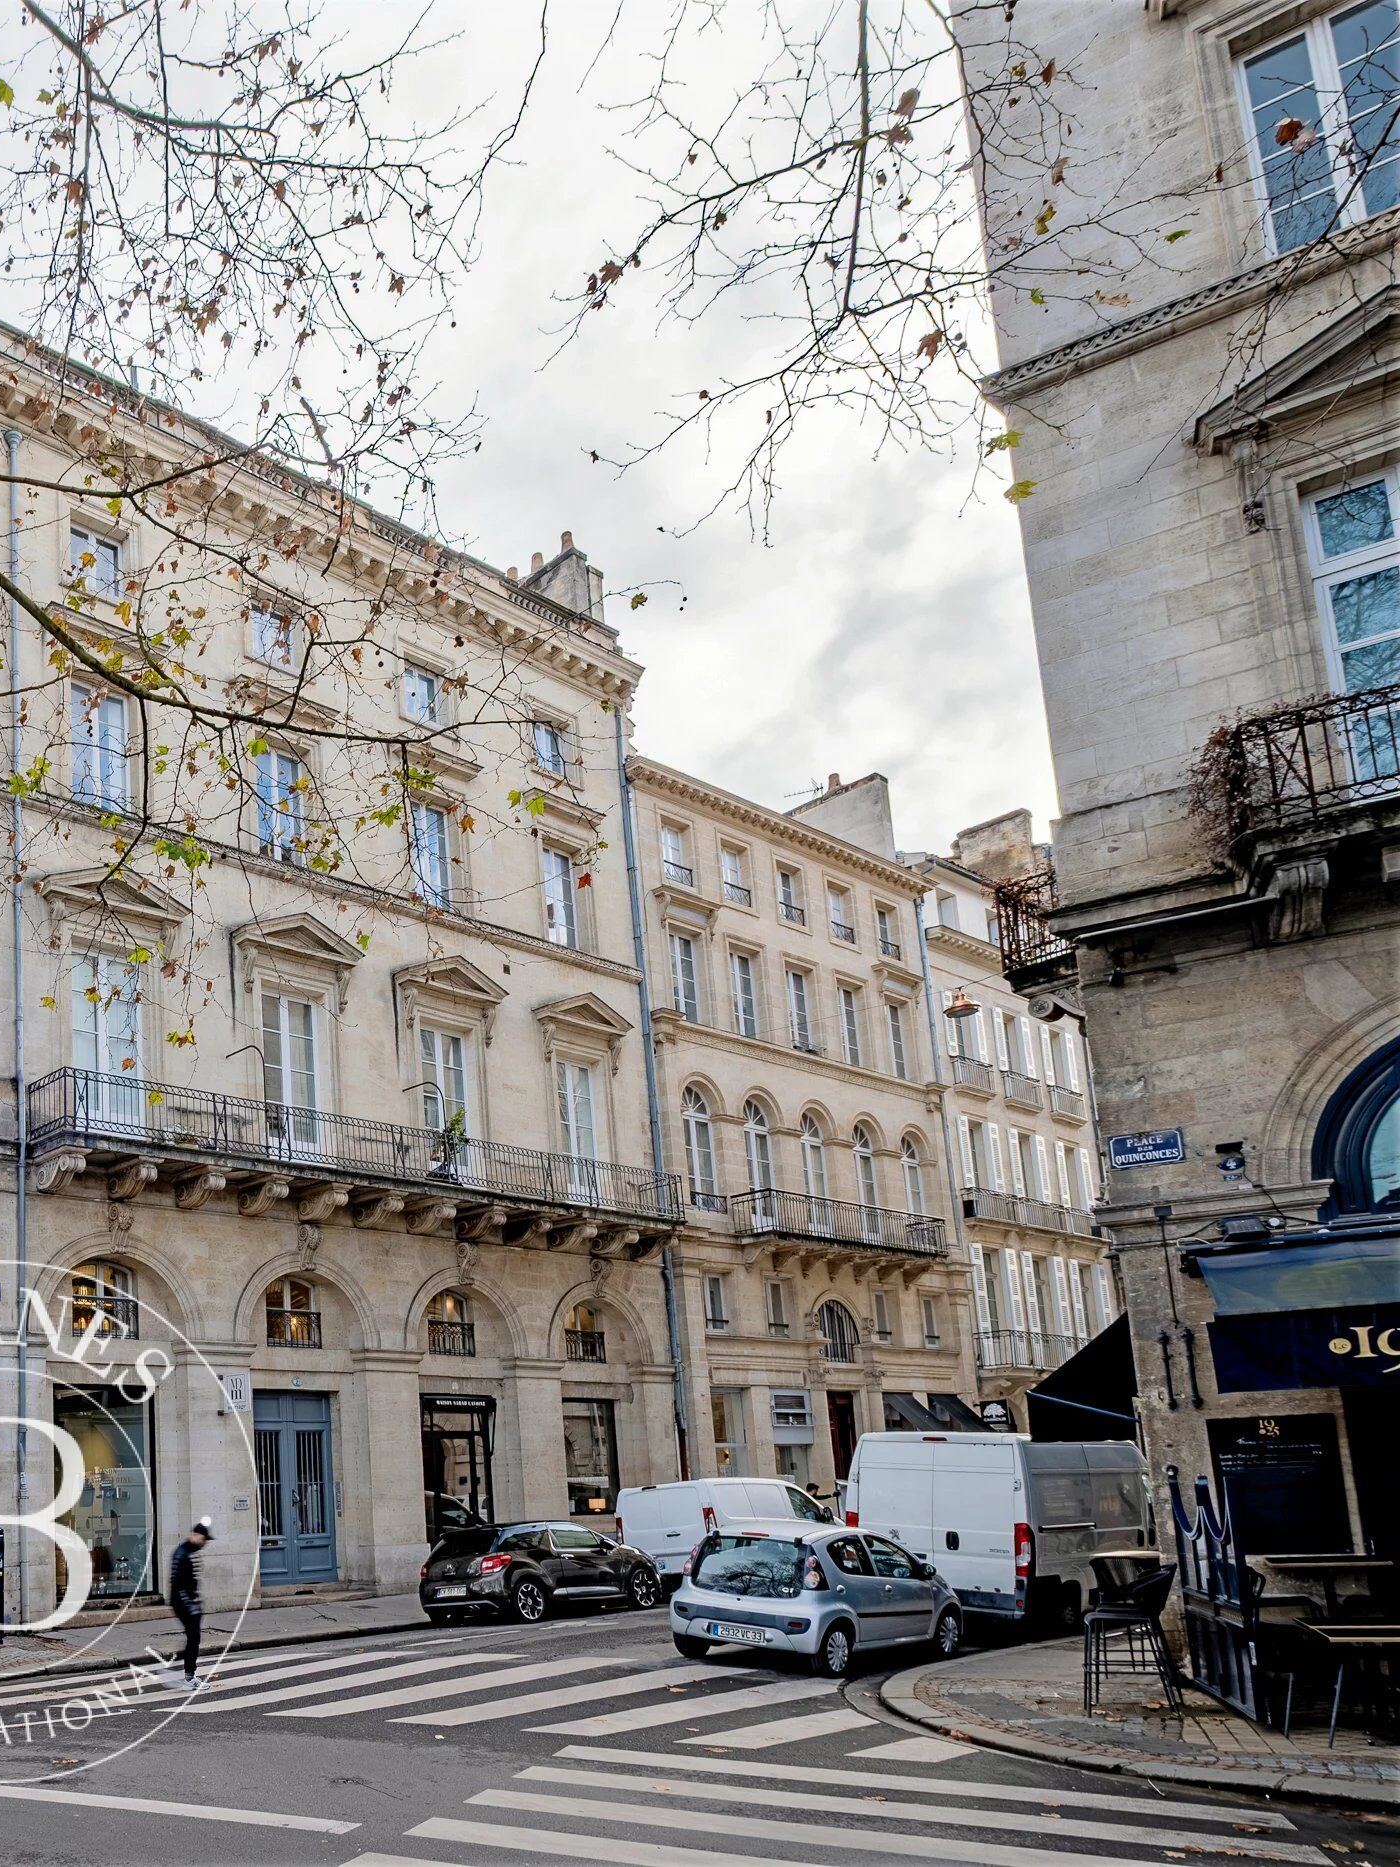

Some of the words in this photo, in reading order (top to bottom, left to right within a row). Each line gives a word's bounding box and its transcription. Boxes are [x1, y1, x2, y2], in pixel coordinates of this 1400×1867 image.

[1126, 1135, 1164, 1148] PLACE
[1116, 1148, 1179, 1165] QUINCONCES
[1226, 1158, 1236, 1169] 4
